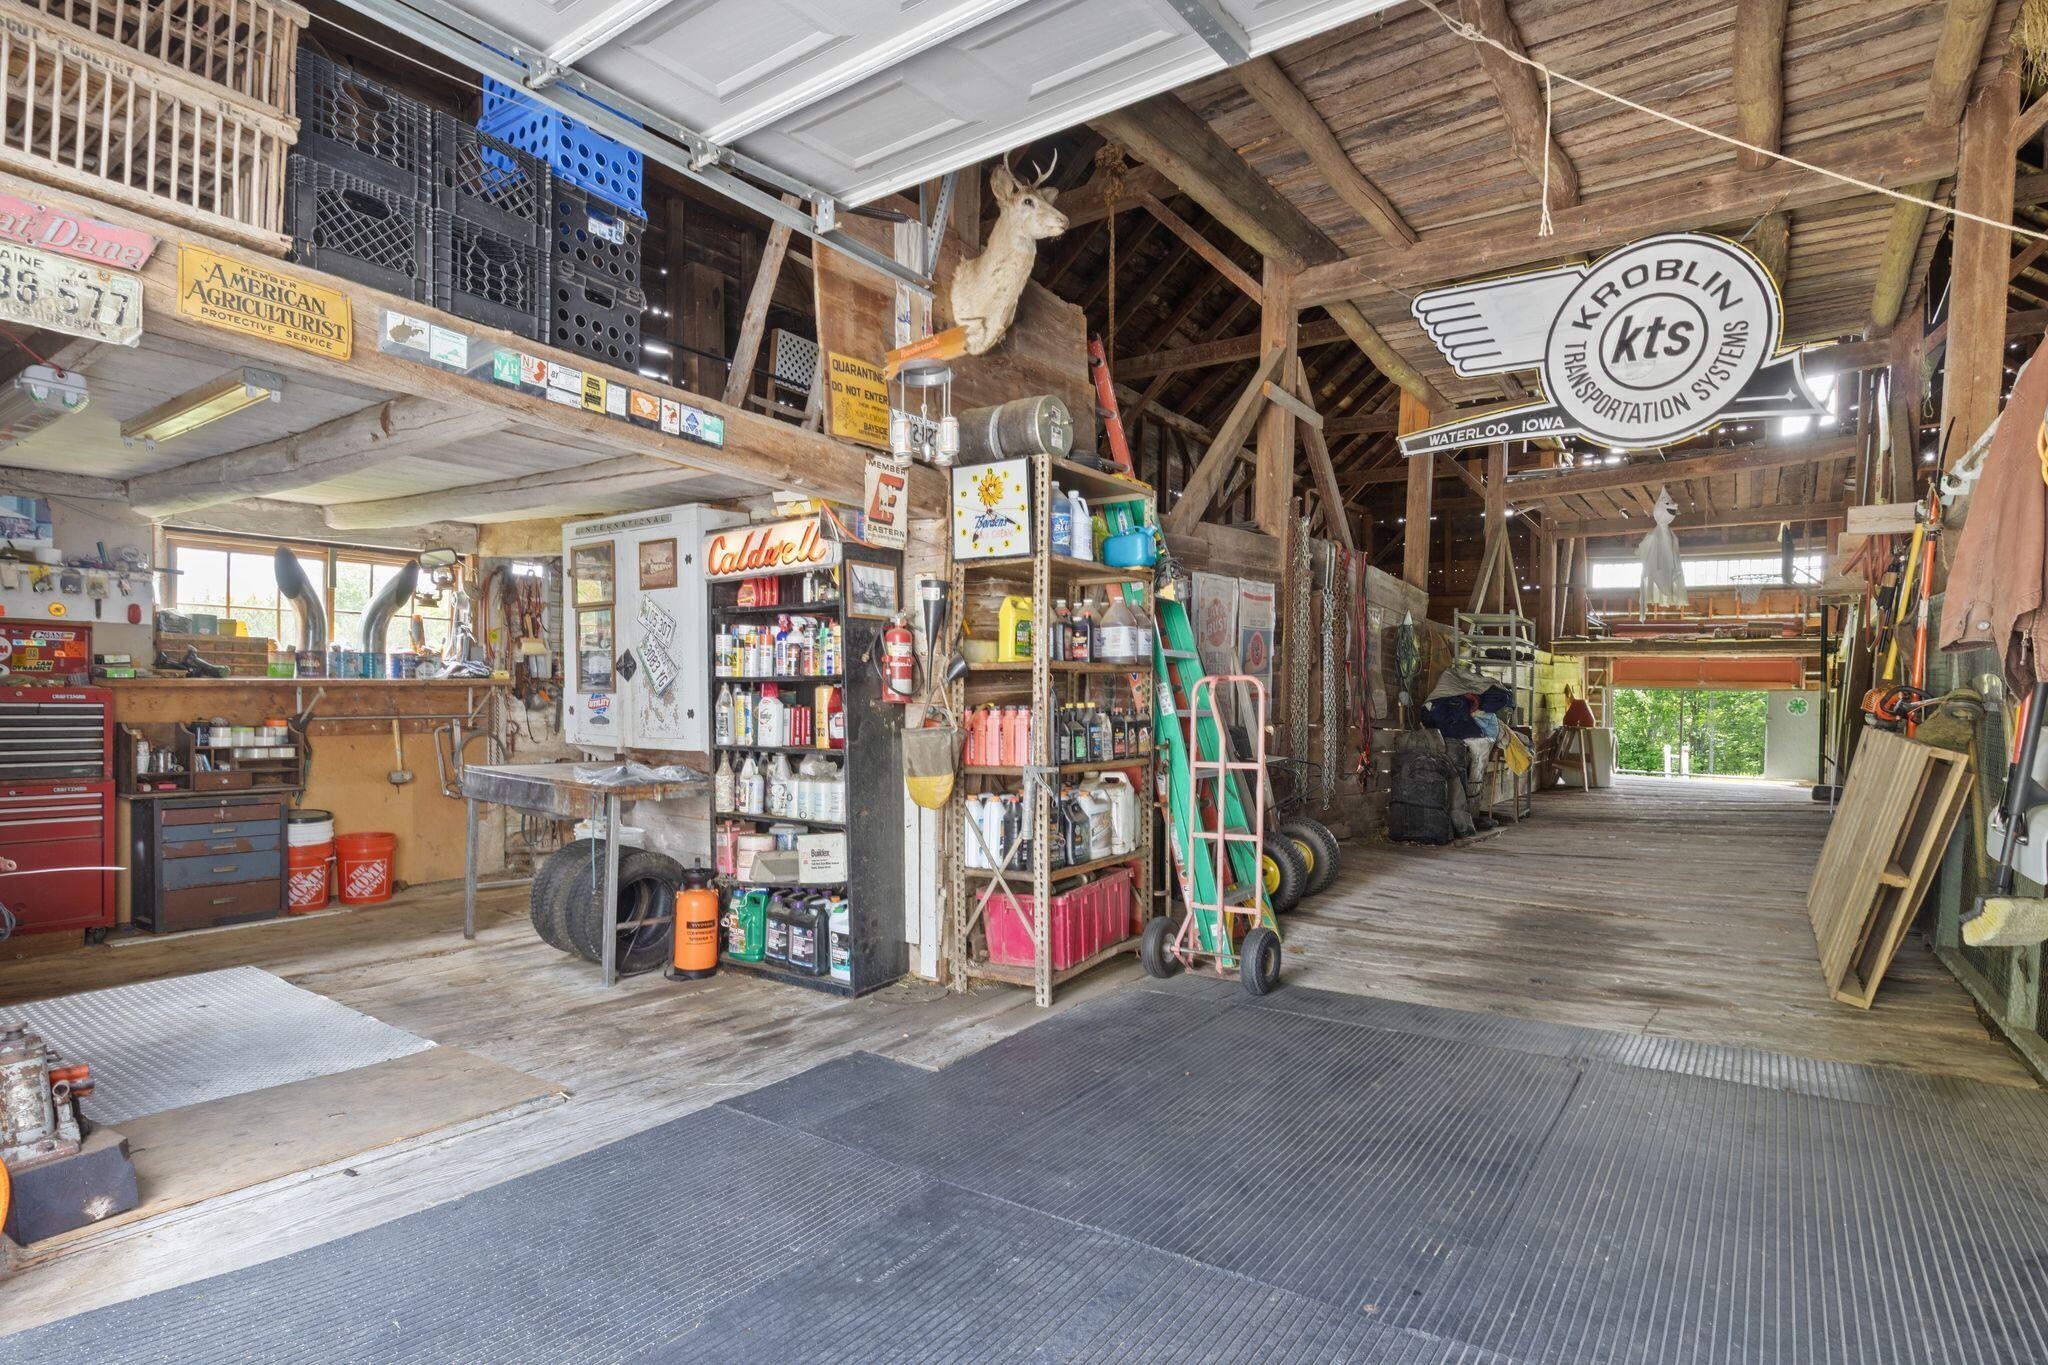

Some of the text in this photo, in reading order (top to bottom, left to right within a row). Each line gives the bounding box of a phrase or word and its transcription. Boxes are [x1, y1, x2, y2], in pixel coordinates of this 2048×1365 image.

[38, 214, 144, 266] Dane
[205, 262, 327, 315] AMERICAN
[240, 266, 297, 289] MEMBER
[185, 279, 346, 341] AGRICULTURIST
[1571, 259, 1744, 331] KROBLIN
[201, 306, 333, 350] PROTECTIVE SERVICE
[1611, 315, 1695, 364] kts
[832, 359, 885, 385] QUARANTINE
[1563, 320, 1749, 424] TRANSPORTATION SYSTEMS
[831, 380, 888, 405] DO NOT ENTER
[1428, 416, 1566, 447] WATERLOO, IOWA
[868, 460, 906, 475] MEMBER
[867, 523, 905, 538] EASTERN
[708, 521, 827, 576] Caldwell
[1206, 615, 1228, 633] BUST
[346, 860, 385, 898] HOME
[349, 863, 366, 880] THE
[361, 873, 386, 898] DEPOT
